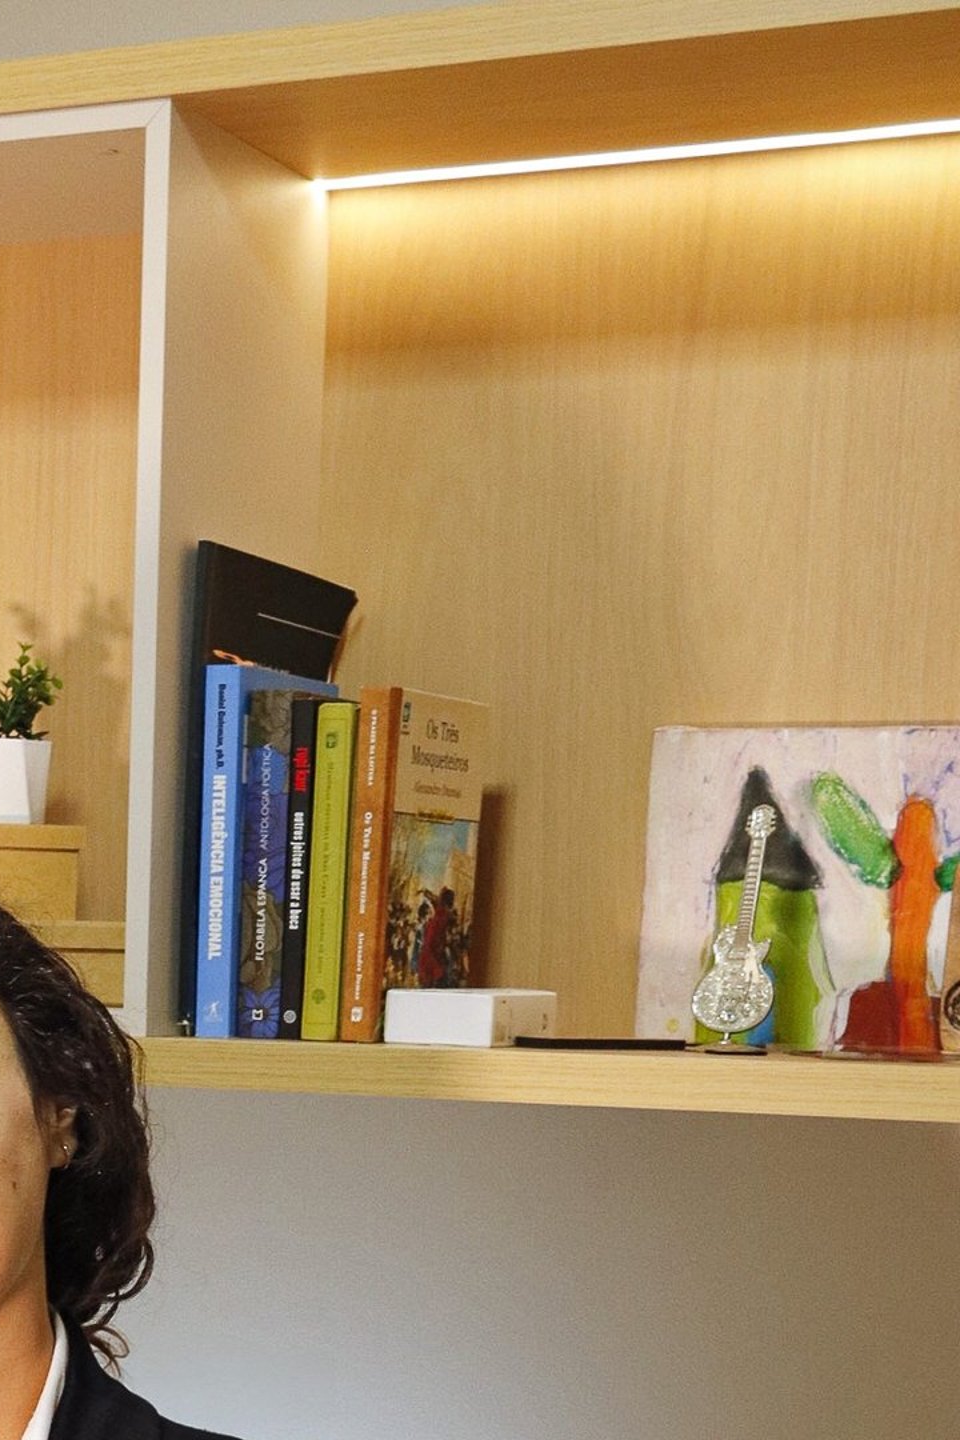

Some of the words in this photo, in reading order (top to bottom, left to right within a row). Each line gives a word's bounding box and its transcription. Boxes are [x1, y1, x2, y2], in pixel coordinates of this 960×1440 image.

[426, 719, 438, 740] Os
[440, 722, 460, 743] Três
[411, 744, 470, 773] Mosqueteiros
[210, 774, 227, 874] INTELIGÊNCIA
[257, 858, 268, 906] ESPANCA
[207, 876, 223, 961] EMOCIONAL
[255, 908, 266, 961] FLORBELA
[289, 908, 303, 931] boca
